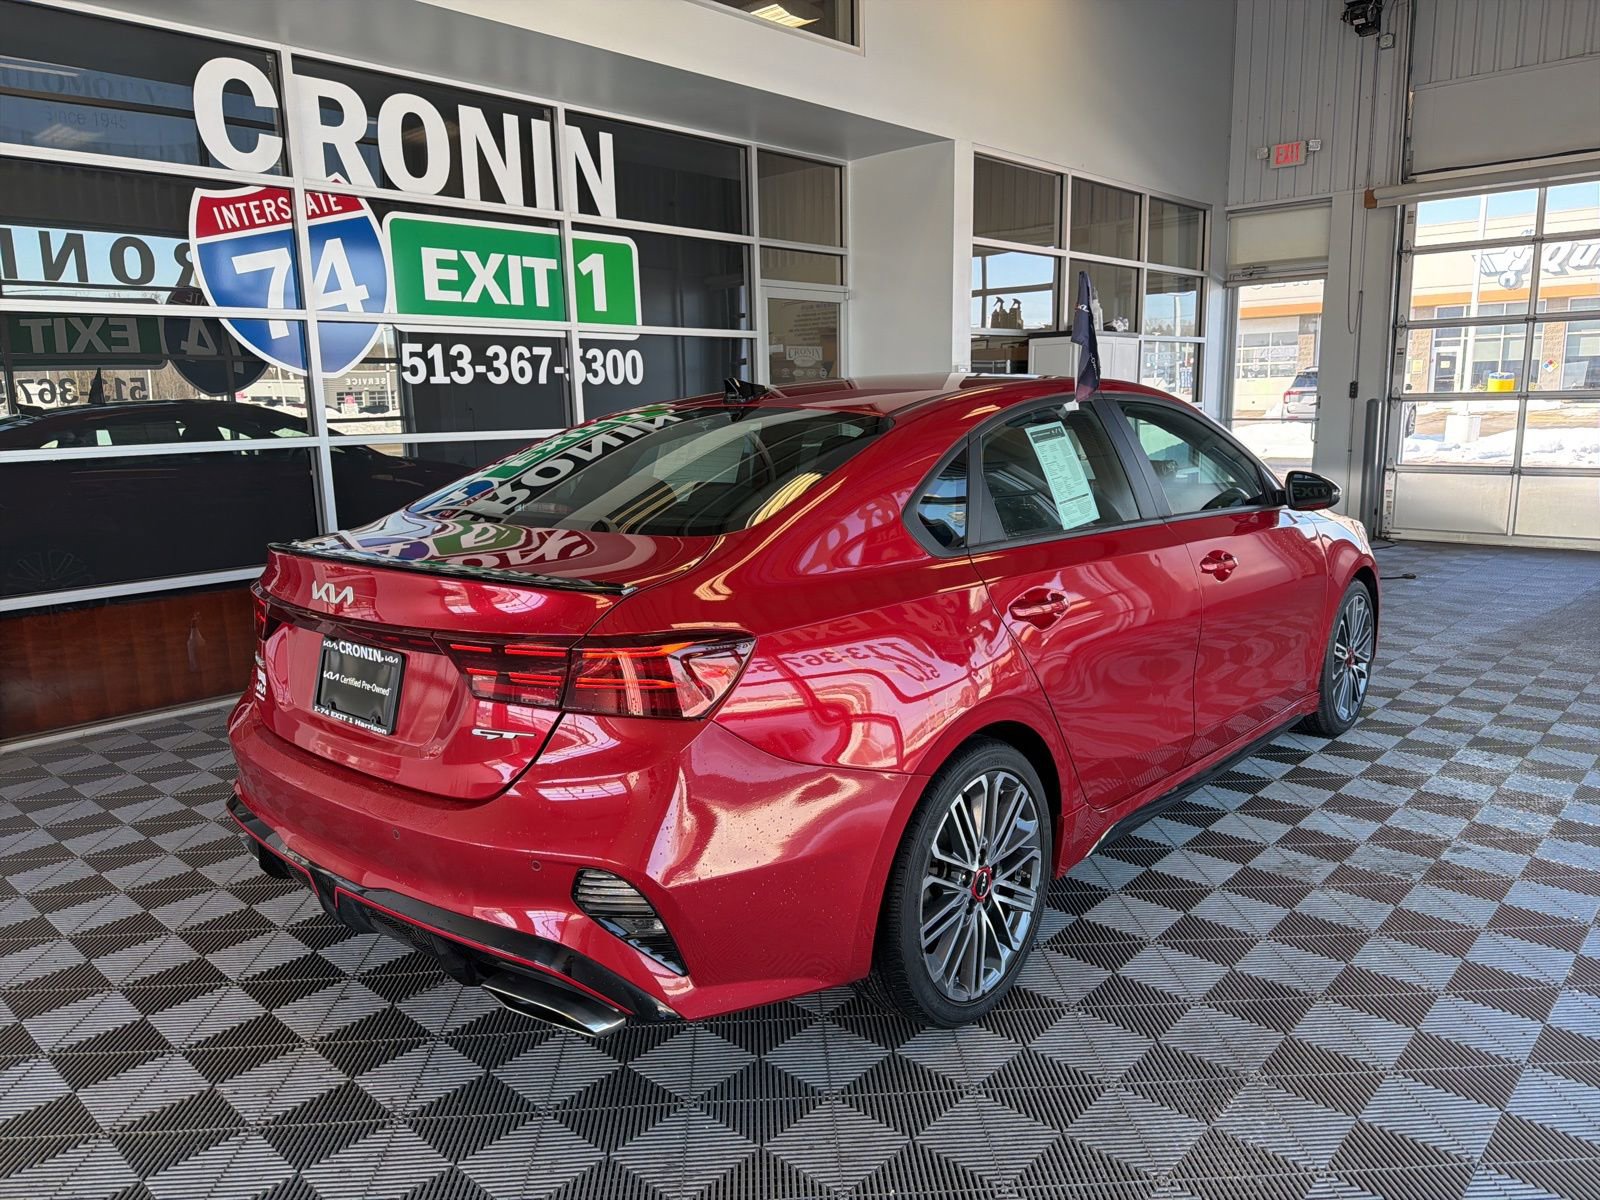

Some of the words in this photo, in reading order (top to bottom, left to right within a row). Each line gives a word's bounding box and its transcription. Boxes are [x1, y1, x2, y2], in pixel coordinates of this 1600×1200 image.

[193, 56, 617, 219] CRONIN
[1275, 142, 1301, 165] EXIT
[212, 193, 343, 230] INTERSATE
[231, 238, 370, 339] 74
[421, 247, 558, 308] EXIT
[577, 253, 607, 312] 1
[312, 580, 354, 606] KIA
[339, 641, 381, 662] CRONIN
[340, 674, 361, 688] Certified
[361, 680, 390, 696] Pre-Owned
[314, 705, 329, 716] I-74
[330, 711, 348, 722] EXIT
[348, 716, 353, 724] 1
[354, 719, 387, 735] Harrison
